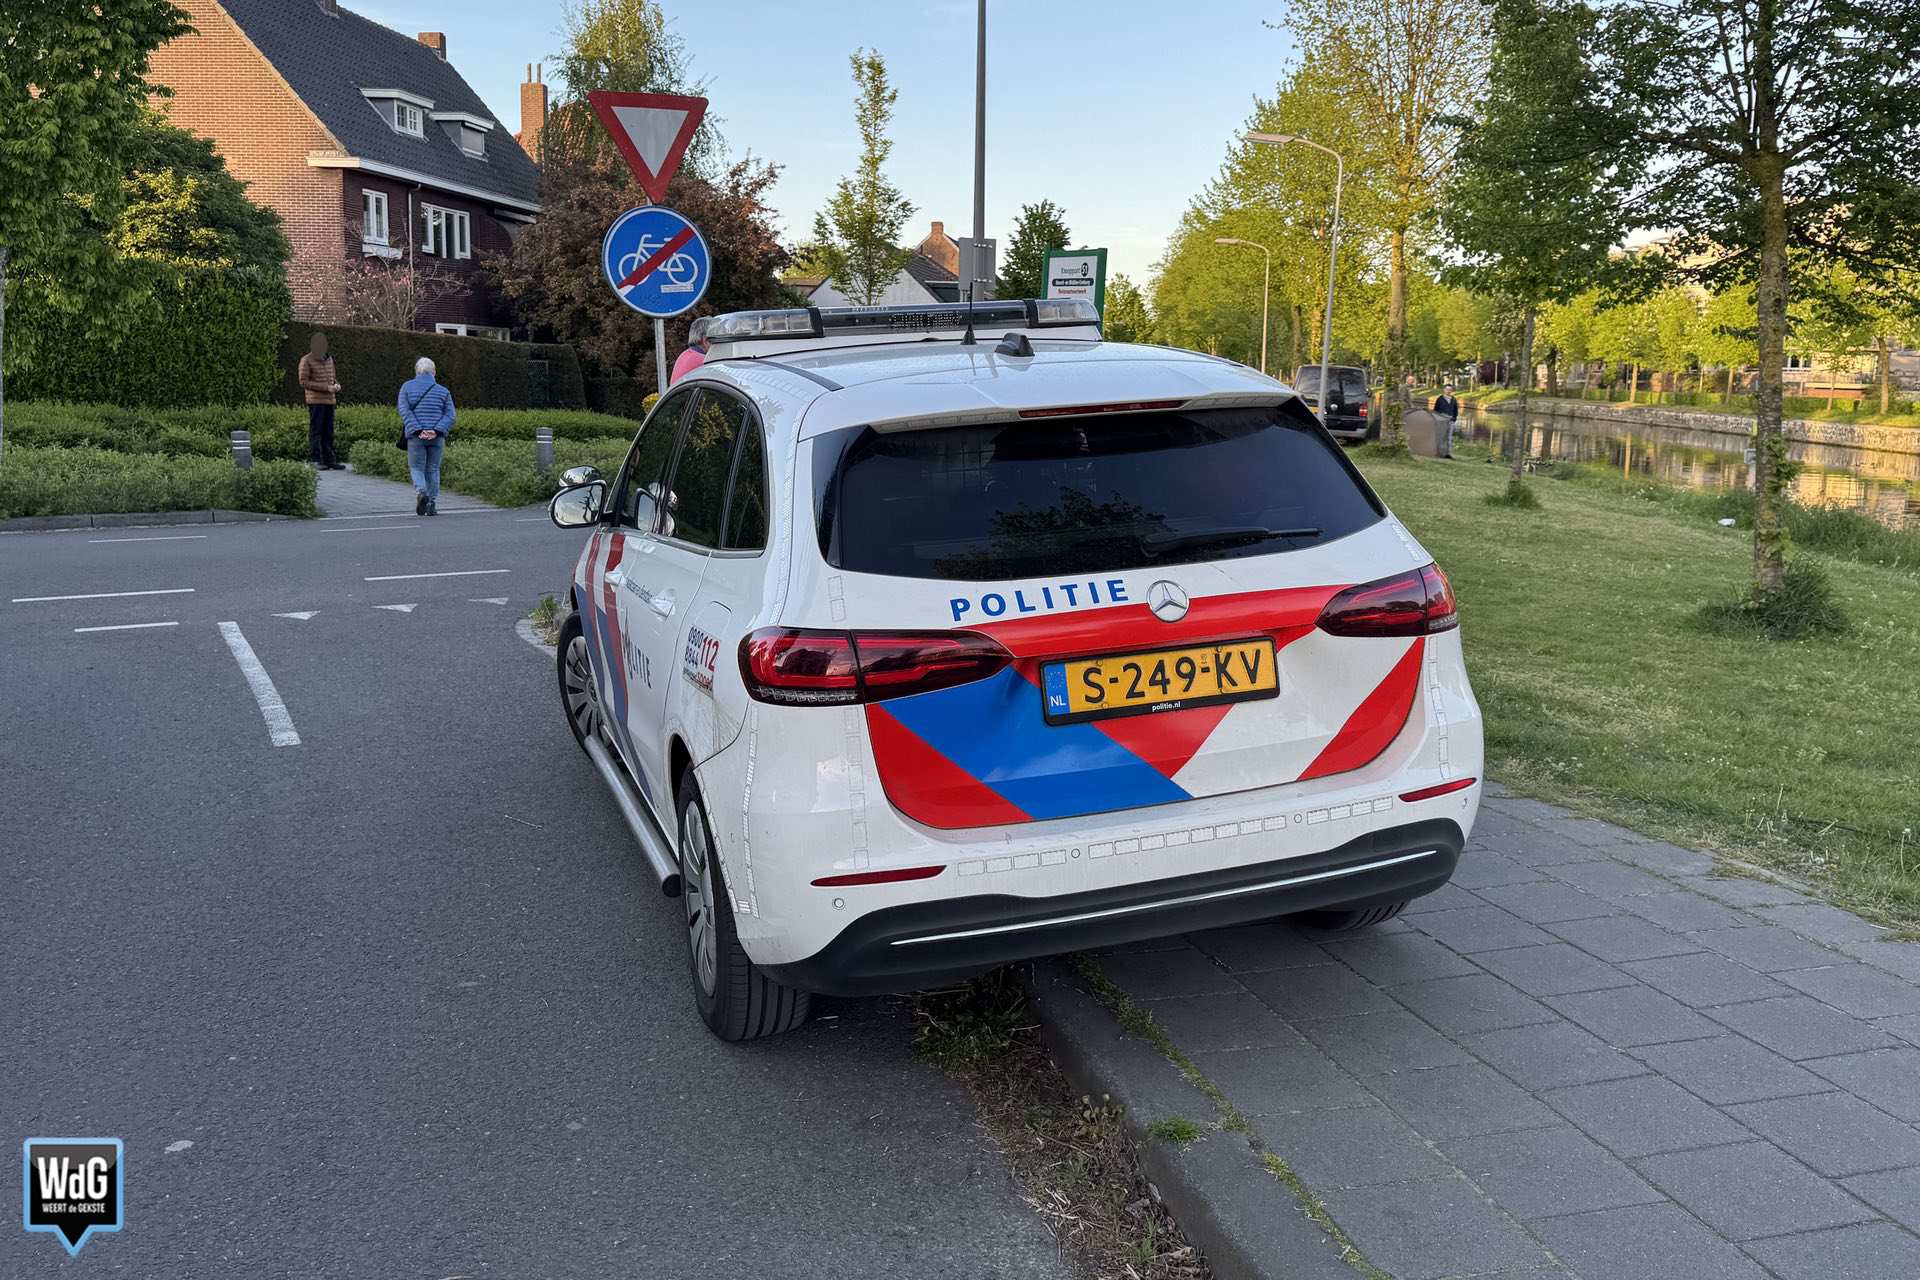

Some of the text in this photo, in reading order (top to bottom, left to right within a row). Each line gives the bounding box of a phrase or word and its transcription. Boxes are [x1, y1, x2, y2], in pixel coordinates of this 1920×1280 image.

[950, 579, 1129, 622] POLITIE
[688, 626, 704, 648] 0900
[622, 632, 652, 689] LITIE
[685, 646, 699, 669] 8844
[700, 635, 720, 672] 112
[1082, 648, 1261, 704] S-249-KV
[1050, 695, 1067, 707] NL
[1151, 701, 1181, 712] politie.nl
